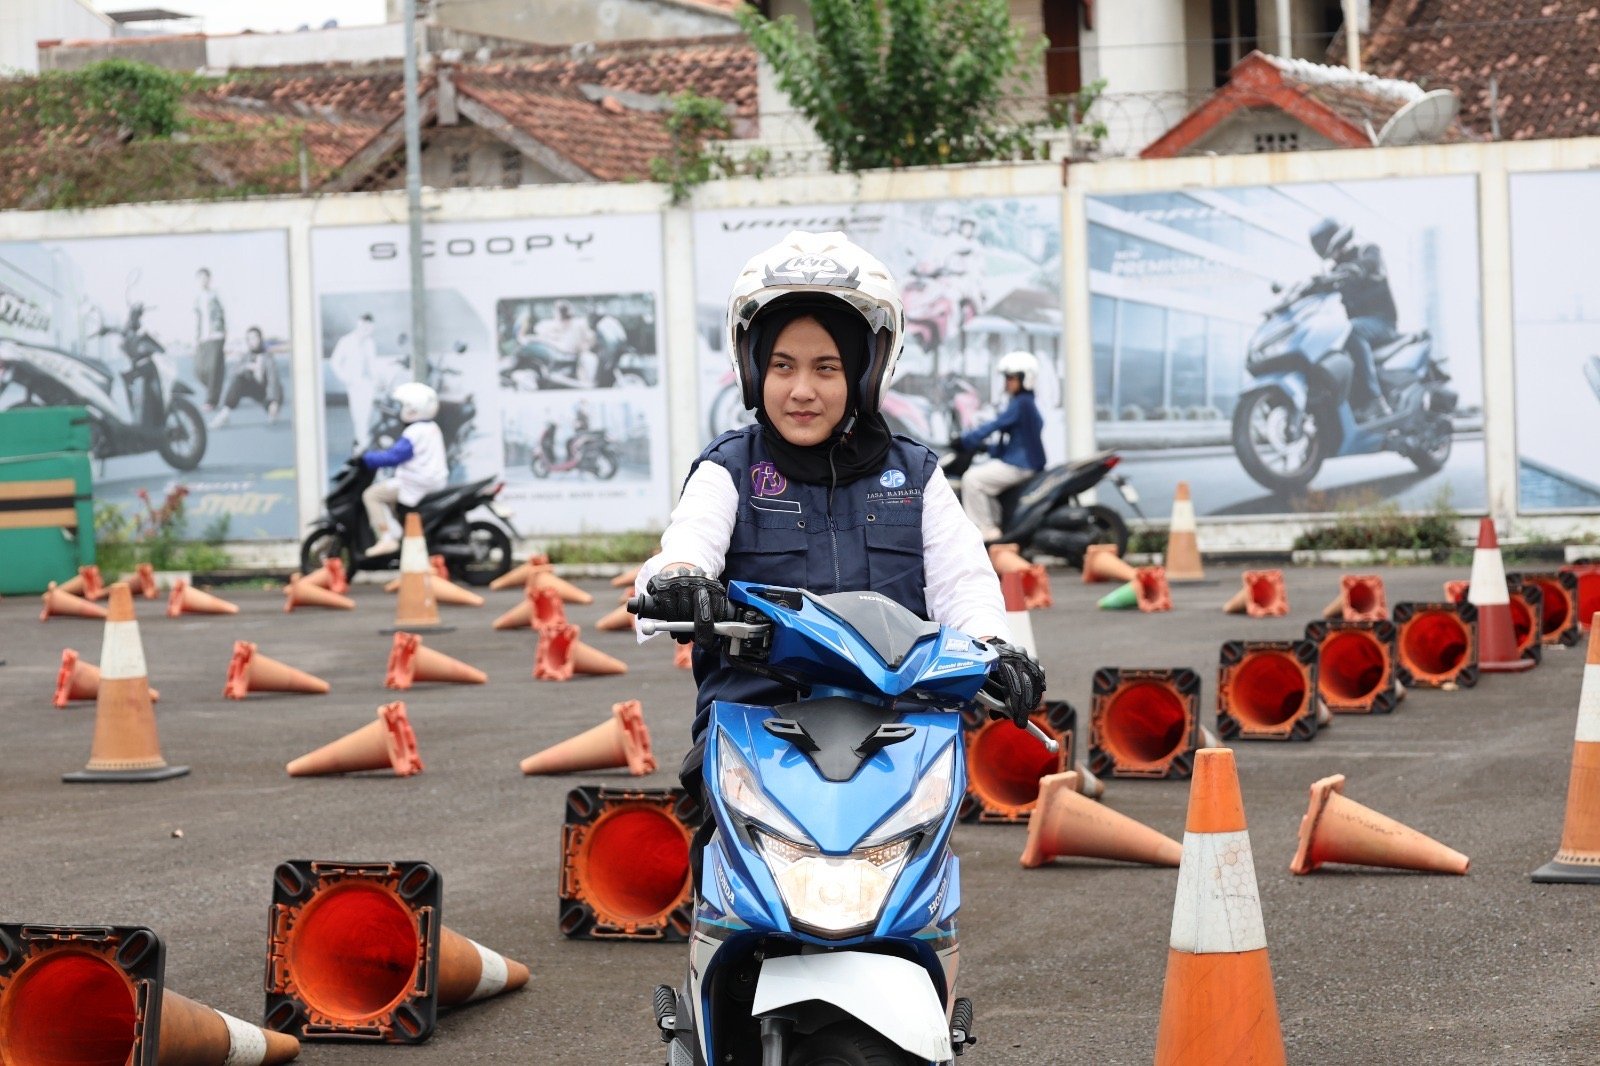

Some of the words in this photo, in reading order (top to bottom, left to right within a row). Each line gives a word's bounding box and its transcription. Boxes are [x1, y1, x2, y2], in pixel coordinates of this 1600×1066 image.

[370, 233, 594, 260] SCOOPY
[866, 492, 884, 500] JASA
[717, 861, 735, 906] HONDA
[927, 876, 948, 916] HONDA
